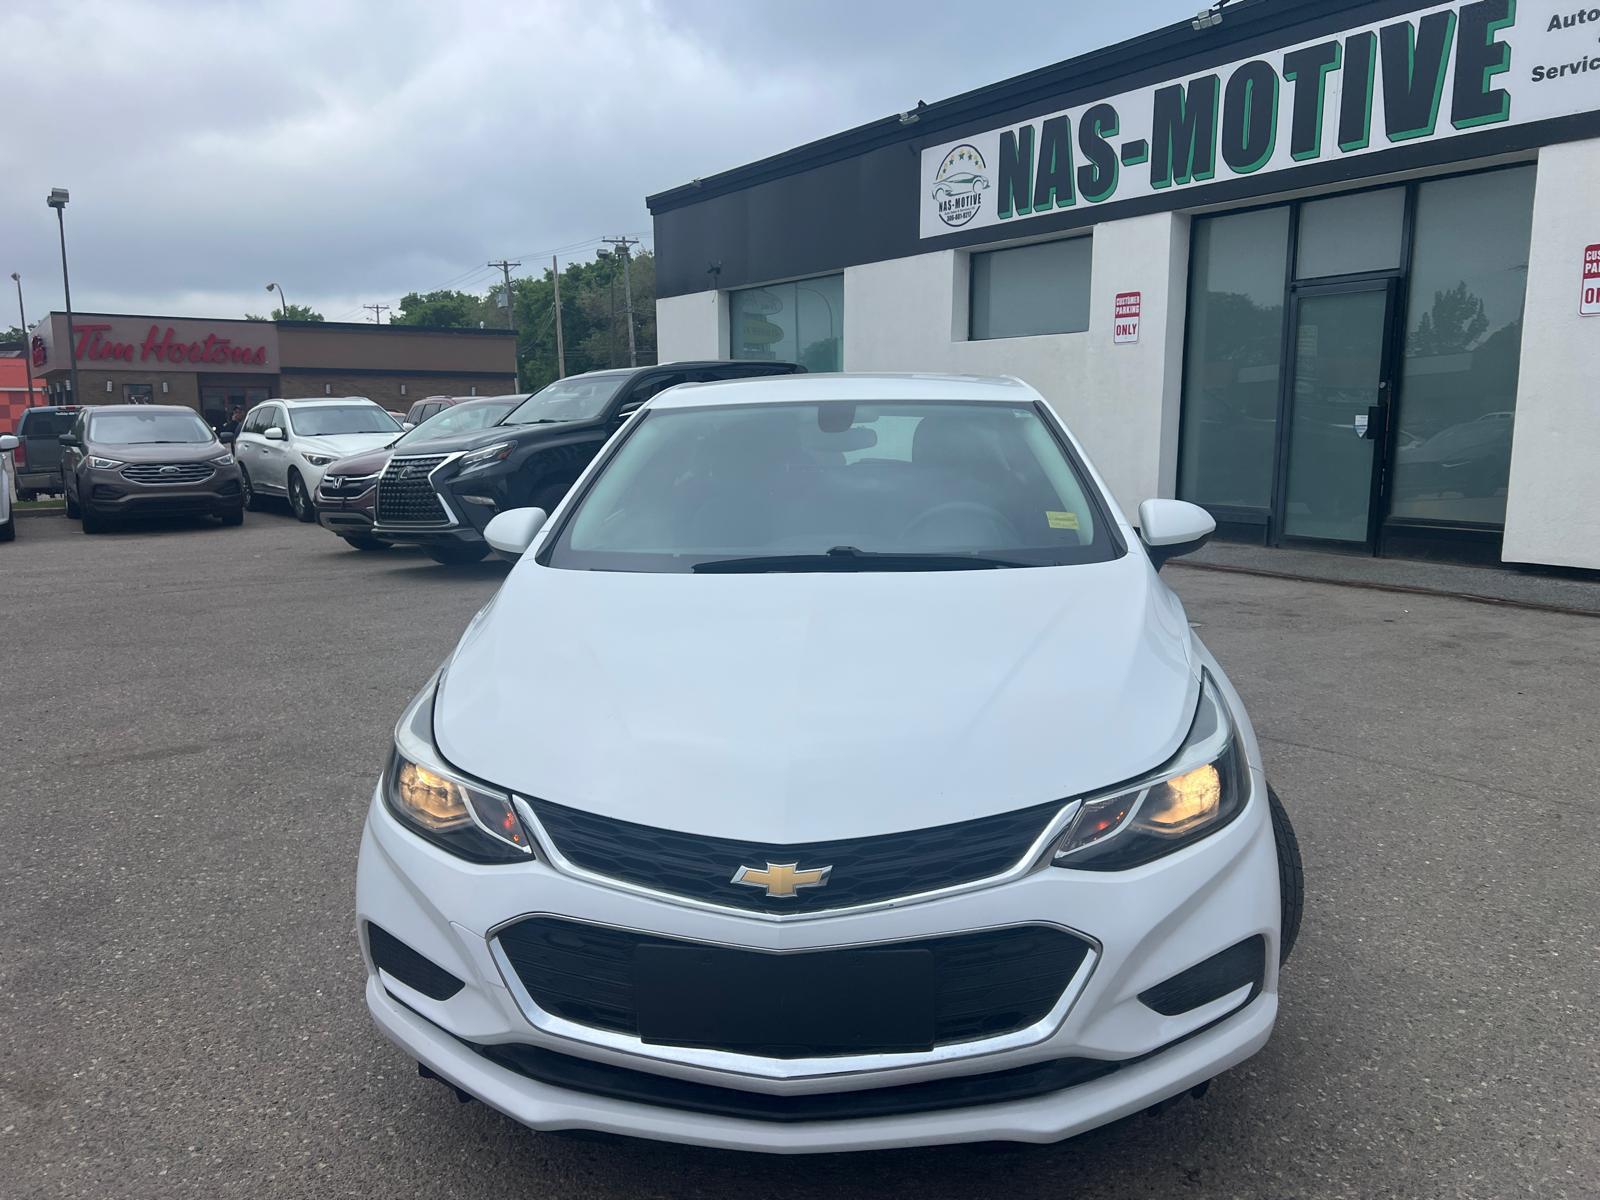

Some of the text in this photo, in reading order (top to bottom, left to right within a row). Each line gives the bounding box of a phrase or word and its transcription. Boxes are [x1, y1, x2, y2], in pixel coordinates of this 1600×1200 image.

[1546, 8, 1600, 33] Auto
[997, 0, 1517, 219] NAS-MOTIVE
[939, 193, 981, 212] NAS-MOTIVE
[1585, 262, 1600, 273] PA
[1115, 305, 1140, 314] PARKING
[1116, 323, 1137, 336] ONLY
[72, 324, 134, 363] Tim
[141, 325, 267, 366] Hortons
